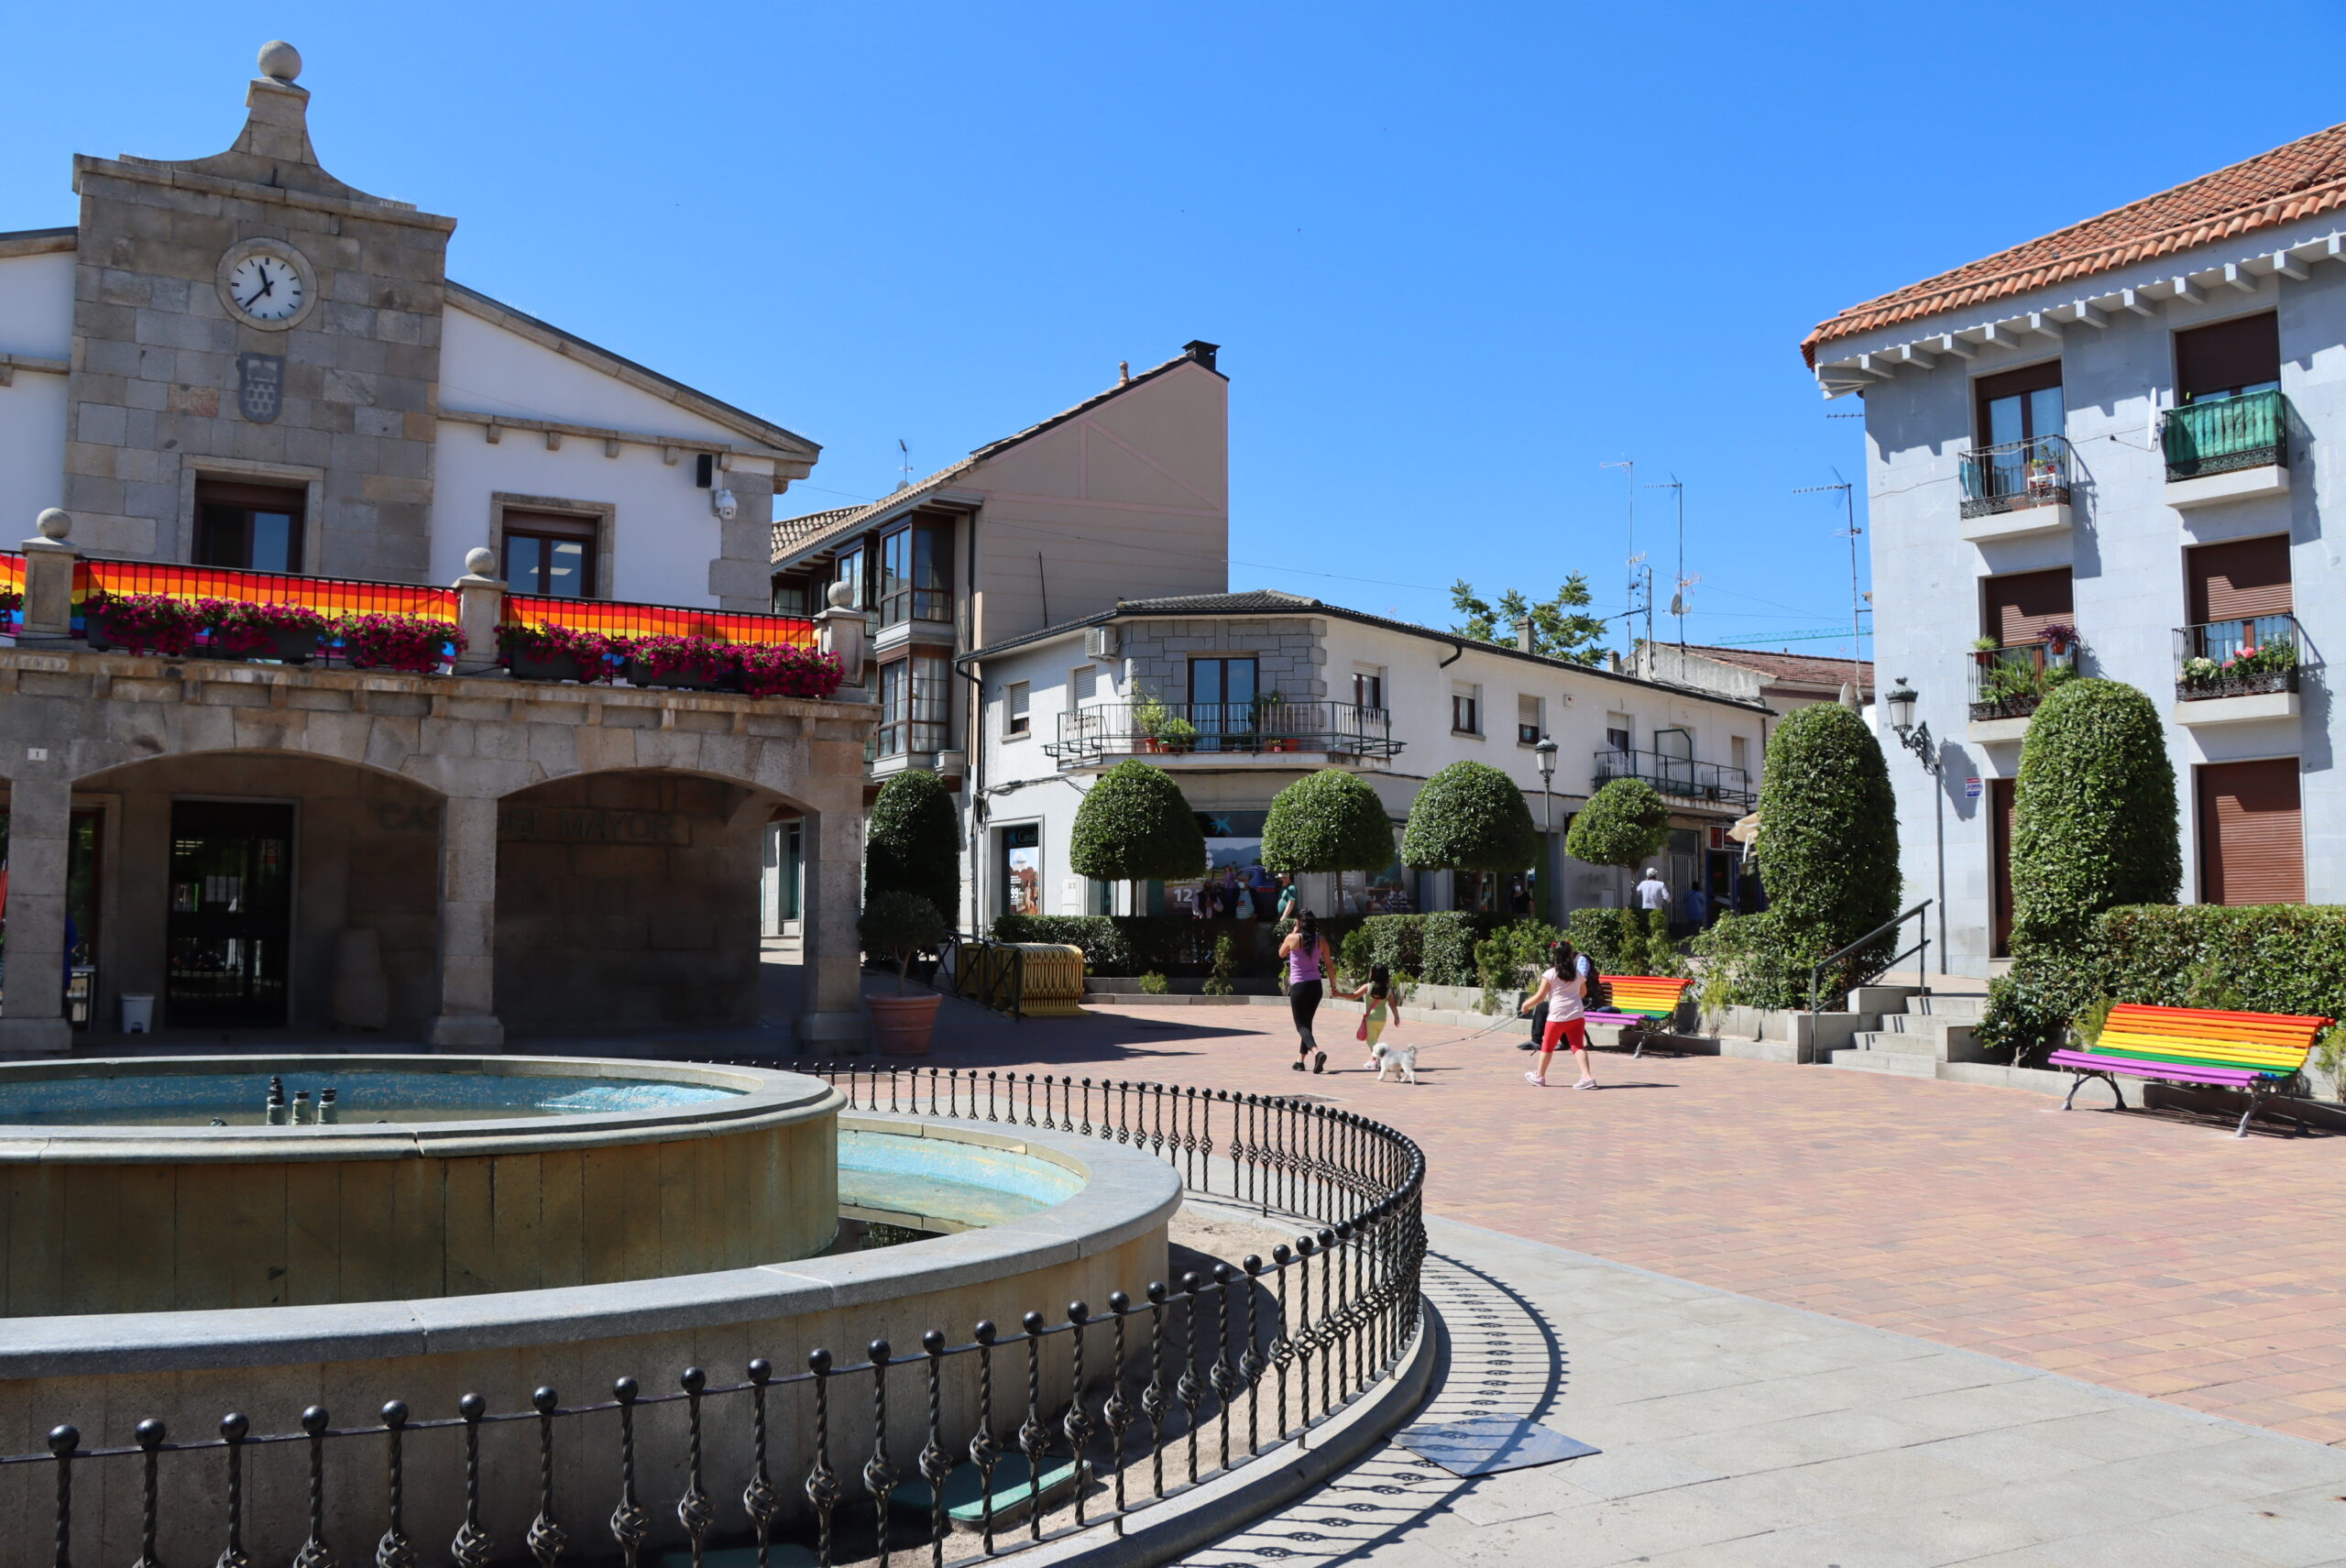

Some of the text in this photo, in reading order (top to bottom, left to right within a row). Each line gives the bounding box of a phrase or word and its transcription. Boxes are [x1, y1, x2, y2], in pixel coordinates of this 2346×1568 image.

[379, 803, 675, 841] CAS EL MAYOR
